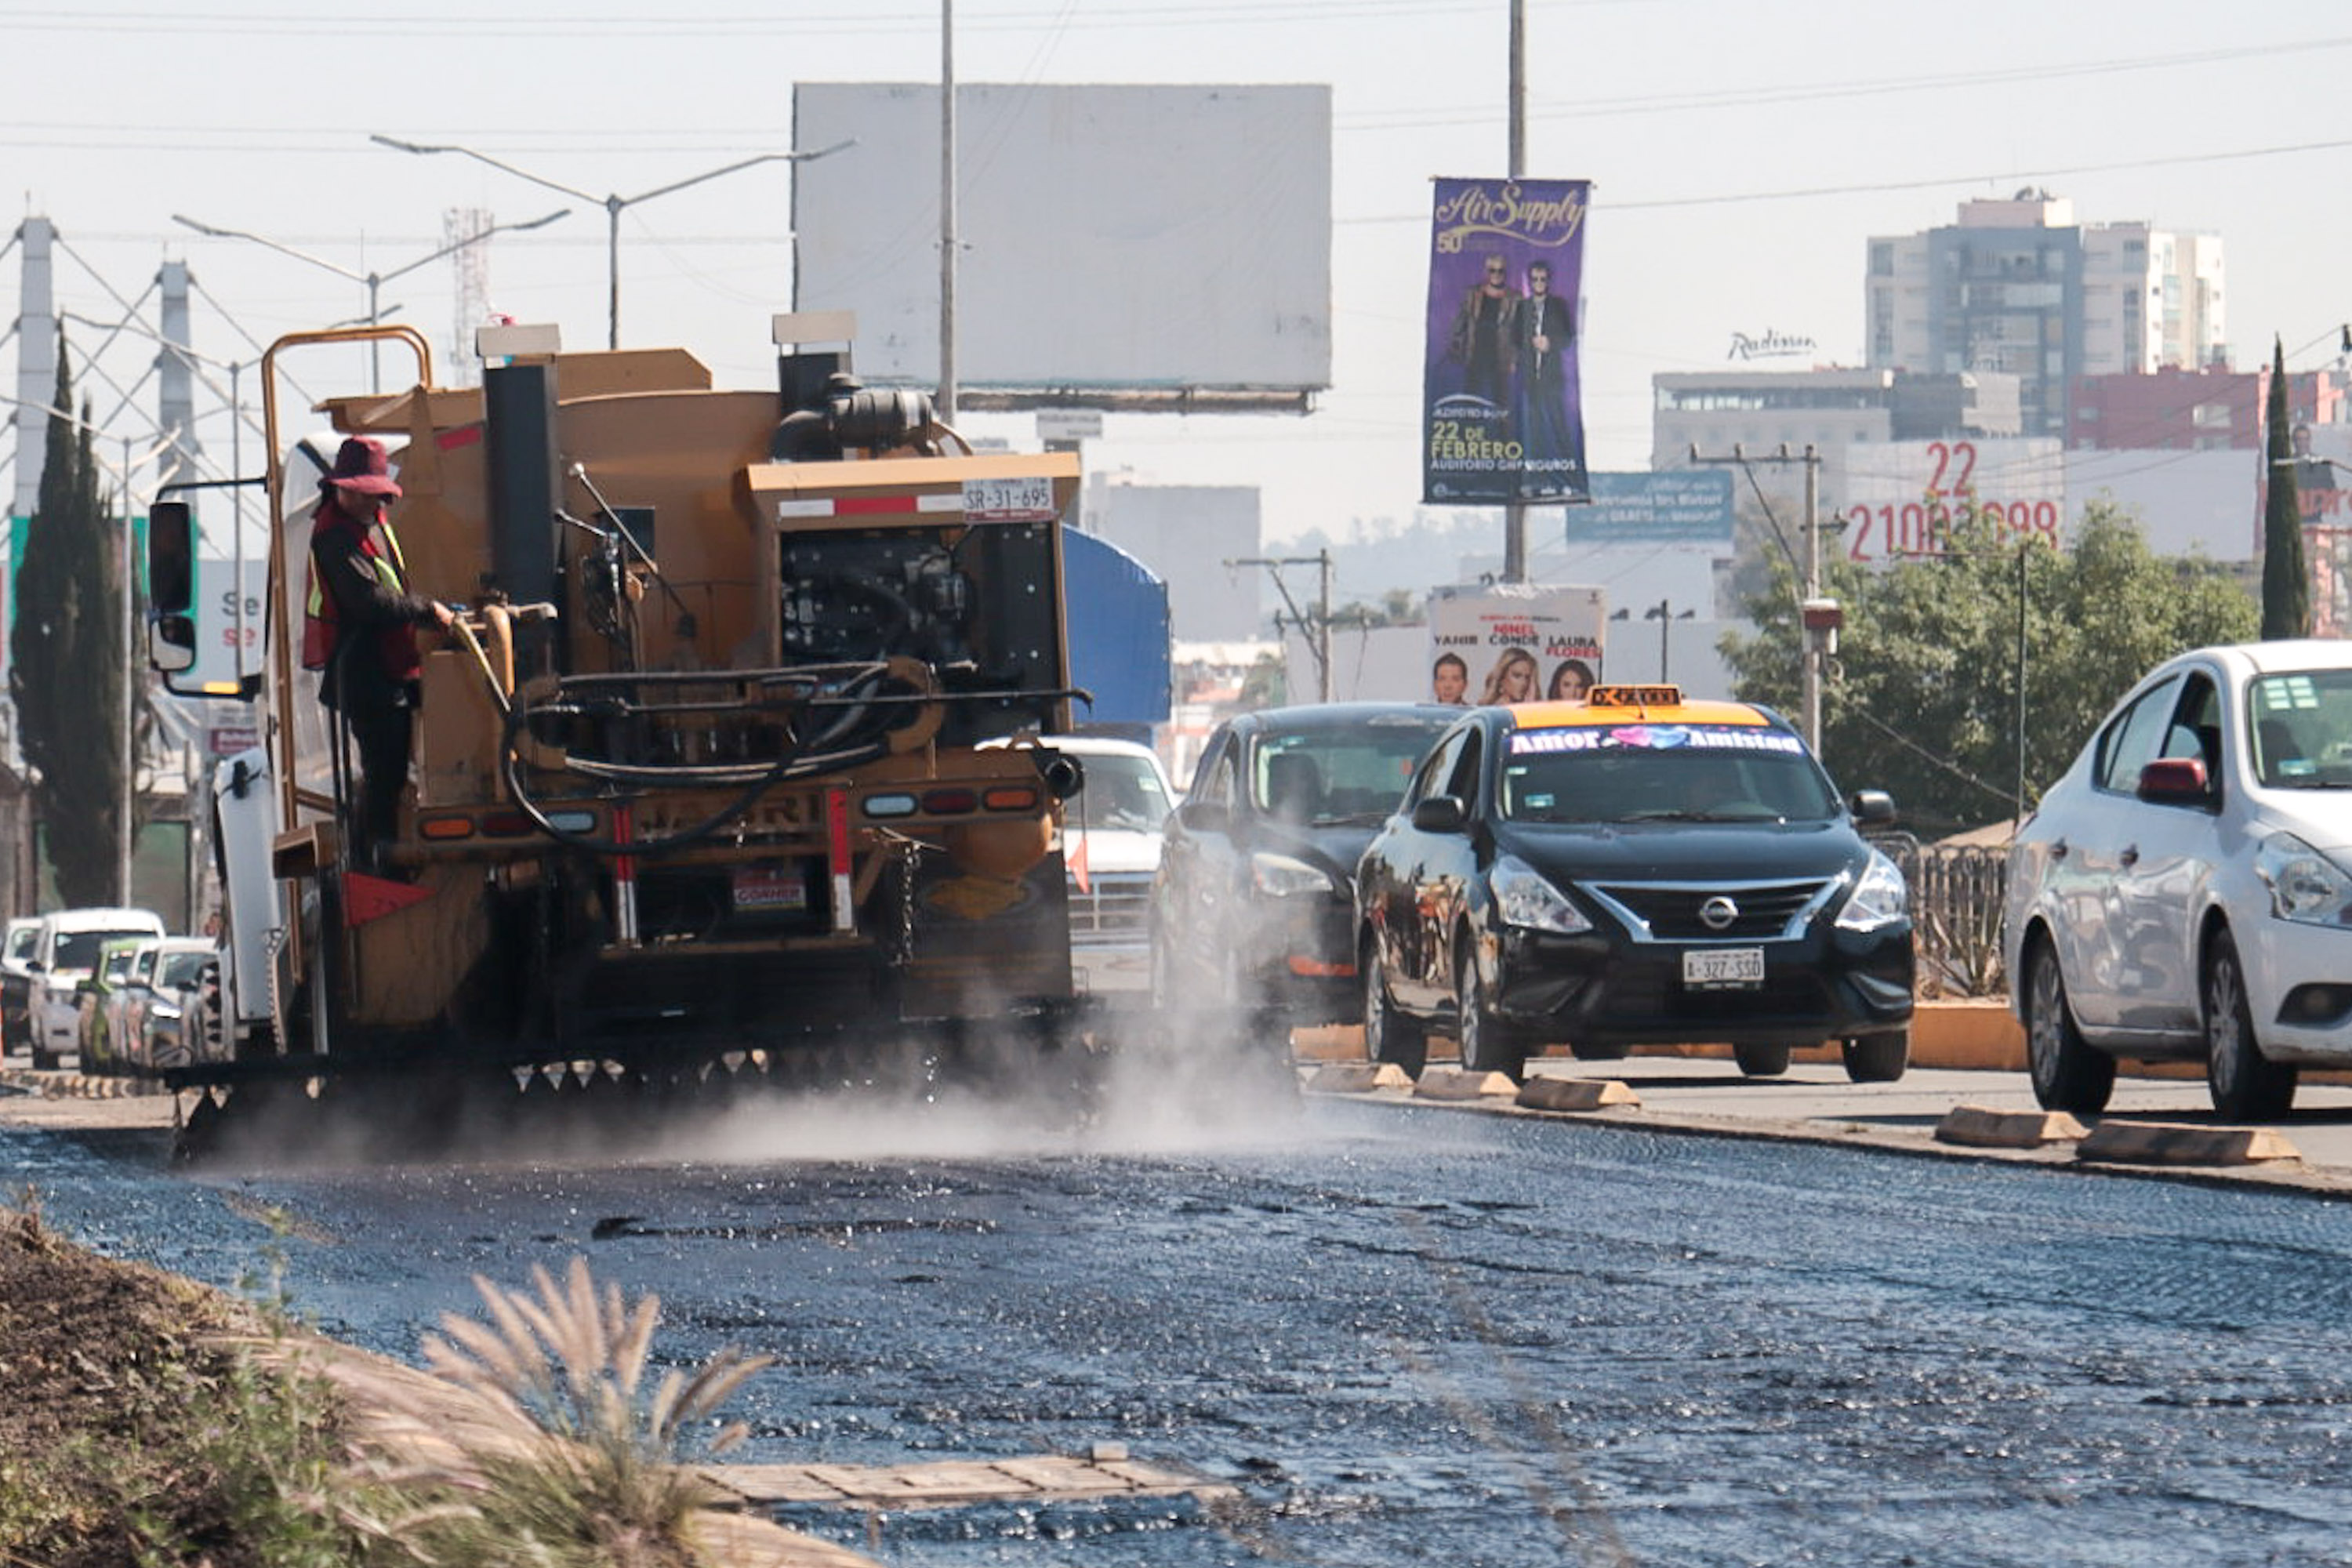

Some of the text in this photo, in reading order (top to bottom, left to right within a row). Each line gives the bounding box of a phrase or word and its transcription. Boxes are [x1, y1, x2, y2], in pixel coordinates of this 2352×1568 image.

[1436, 183, 1585, 240] Air Supply
[1437, 233, 1461, 253] 50
[1432, 421, 1485, 441] 22 DE
[1431, 441, 1523, 459] FEBRERO
[1431, 459, 1494, 471] AUDITORIO
[1926, 440, 1976, 497] 22
[966, 488, 1050, 510] SR-31-695
[1493, 623, 1537, 635] NINEL
[1434, 634, 1597, 648] YAHIR CONDE LAURA
[1545, 647, 1600, 659] FLORES
[1512, 731, 1600, 754] Amor
